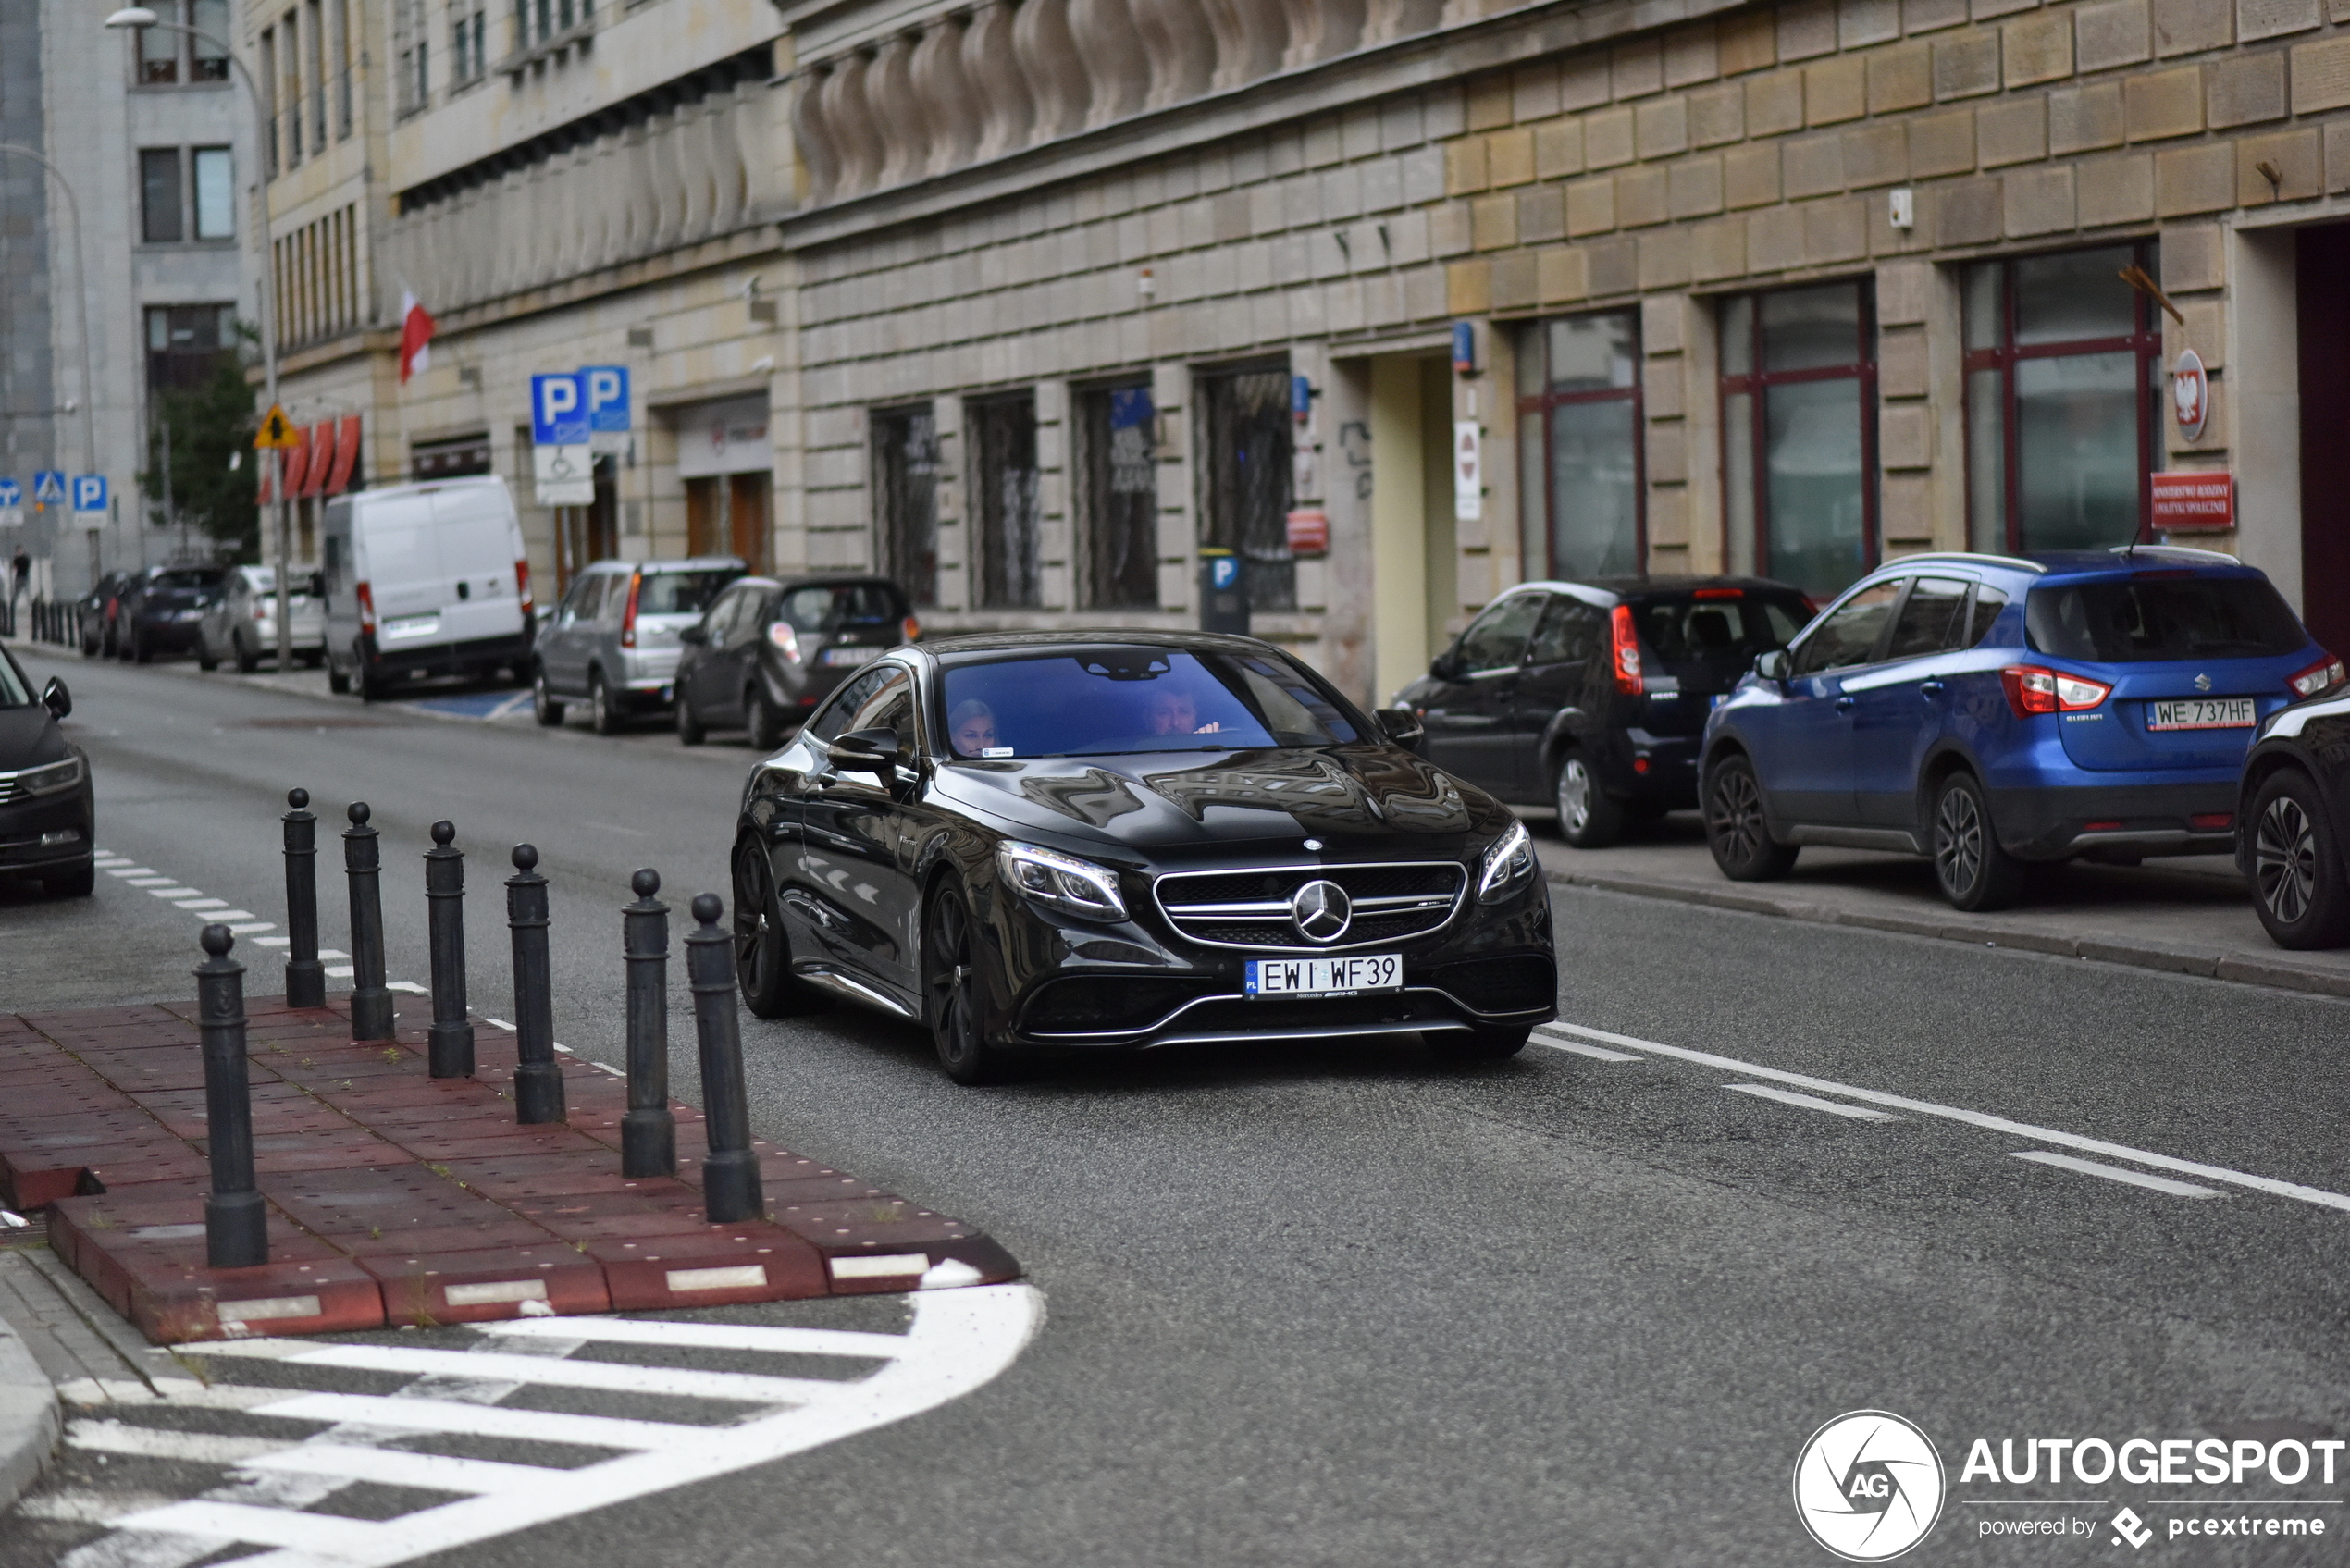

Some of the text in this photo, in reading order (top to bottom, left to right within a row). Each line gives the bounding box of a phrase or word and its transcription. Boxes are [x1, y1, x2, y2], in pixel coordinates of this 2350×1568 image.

[542, 377, 577, 426] P
[589, 371, 621, 413] P
[80, 477, 102, 507] P
[1215, 560, 1232, 584] P
[2159, 700, 2252, 723] WE 737HF
[1265, 957, 1396, 990] EWI WF39
